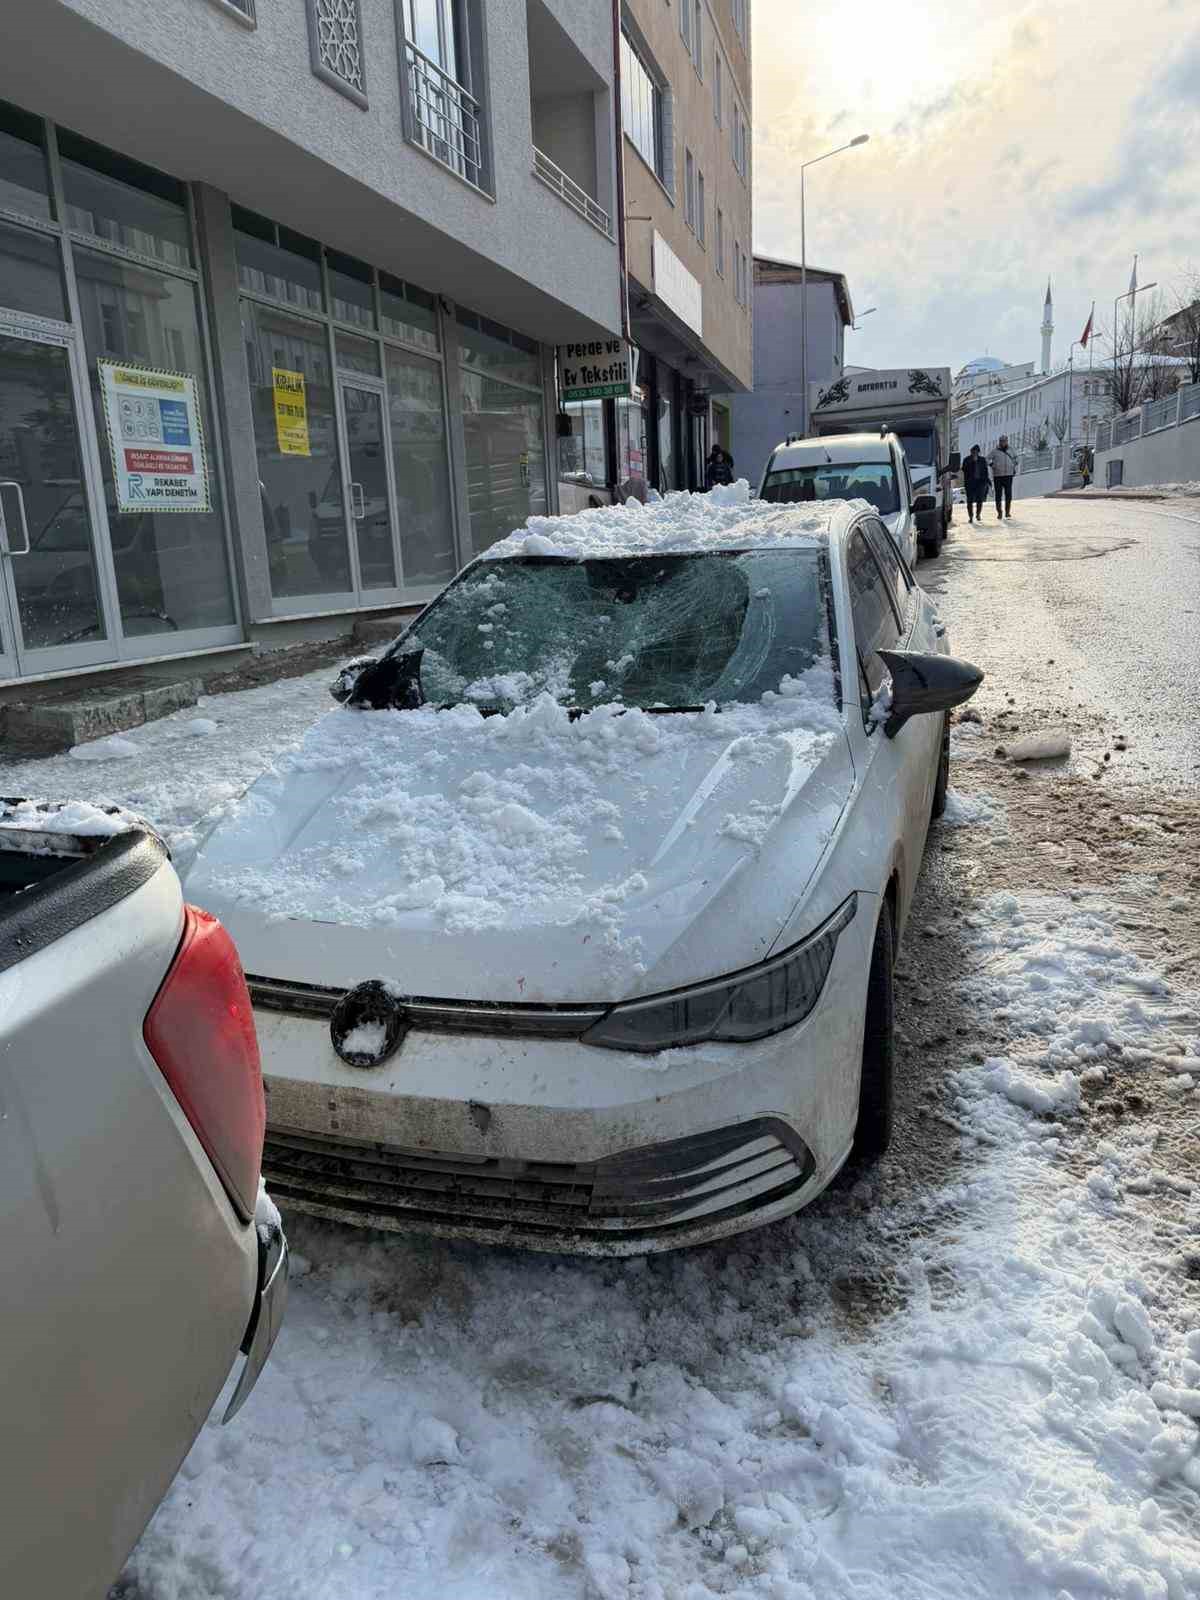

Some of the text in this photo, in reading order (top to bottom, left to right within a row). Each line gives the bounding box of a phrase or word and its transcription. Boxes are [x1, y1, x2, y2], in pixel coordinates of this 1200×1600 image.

[568, 340, 620, 357] Perde ve
[564, 362, 626, 386] Ev Tekstili
[145, 486, 198, 497] YAPI DENETİM
